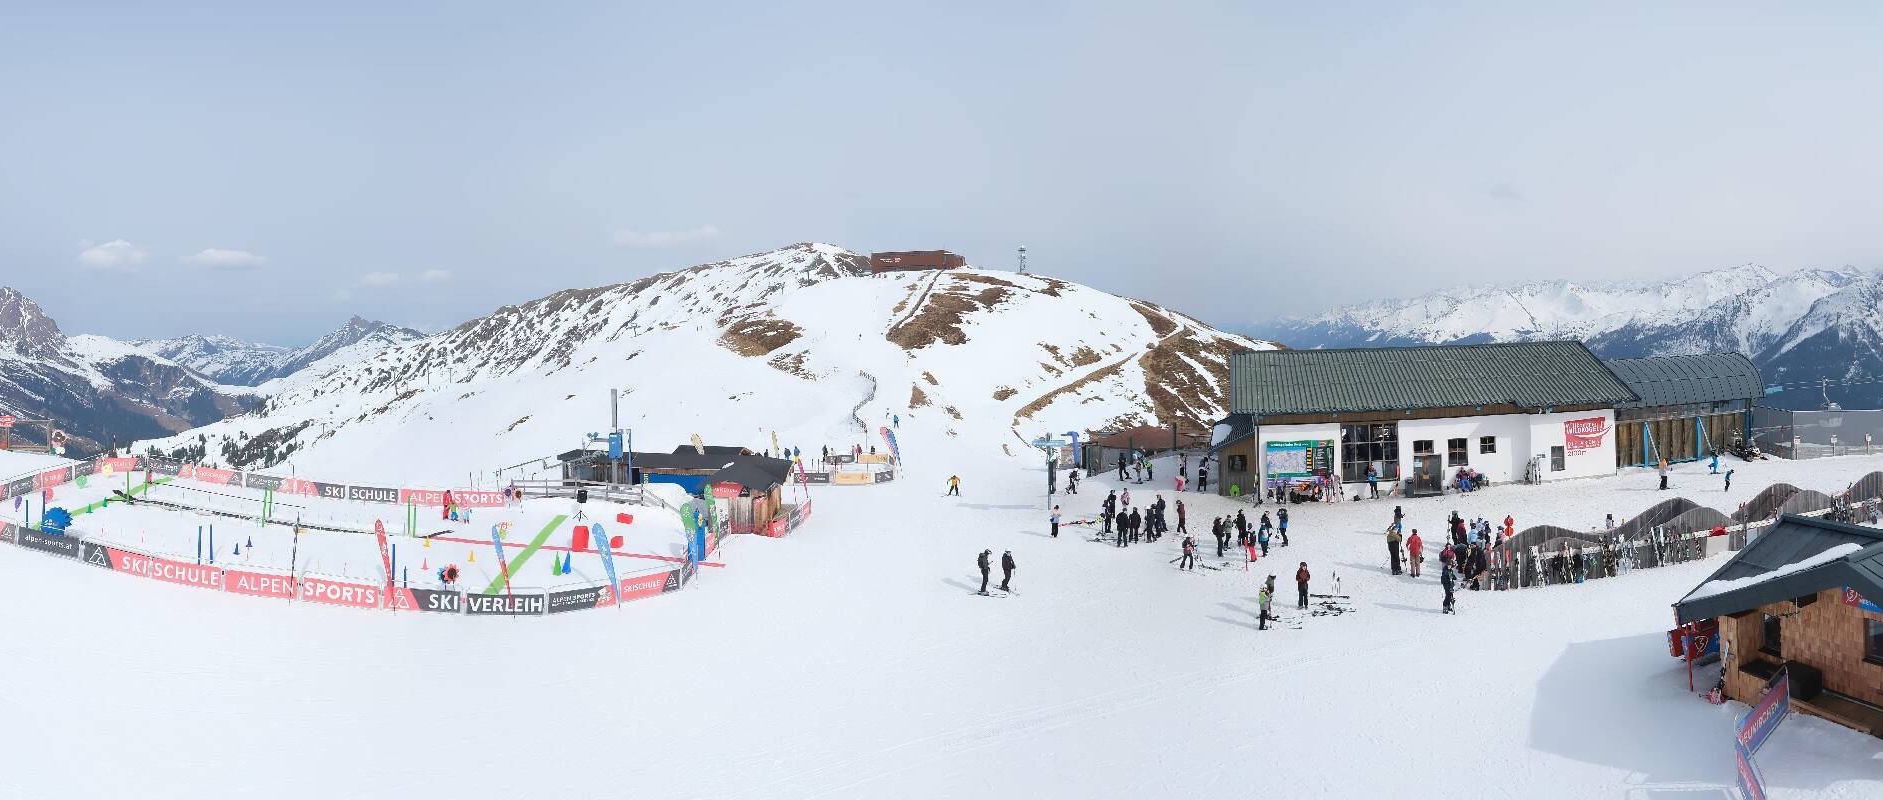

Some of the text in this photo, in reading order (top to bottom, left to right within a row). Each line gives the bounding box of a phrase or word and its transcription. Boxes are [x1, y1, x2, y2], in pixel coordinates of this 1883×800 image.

[324, 486, 396, 502] SKI SCHULE
[24, 534, 73, 551] alpen-sports.at
[121, 556, 219, 586] SKI SCHULE
[237, 576, 375, 605] ALPEN SPORTS
[623, 580, 661, 593] SKISCHULE
[428, 594, 459, 610] SKI
[469, 597, 543, 613] VERLEIH
